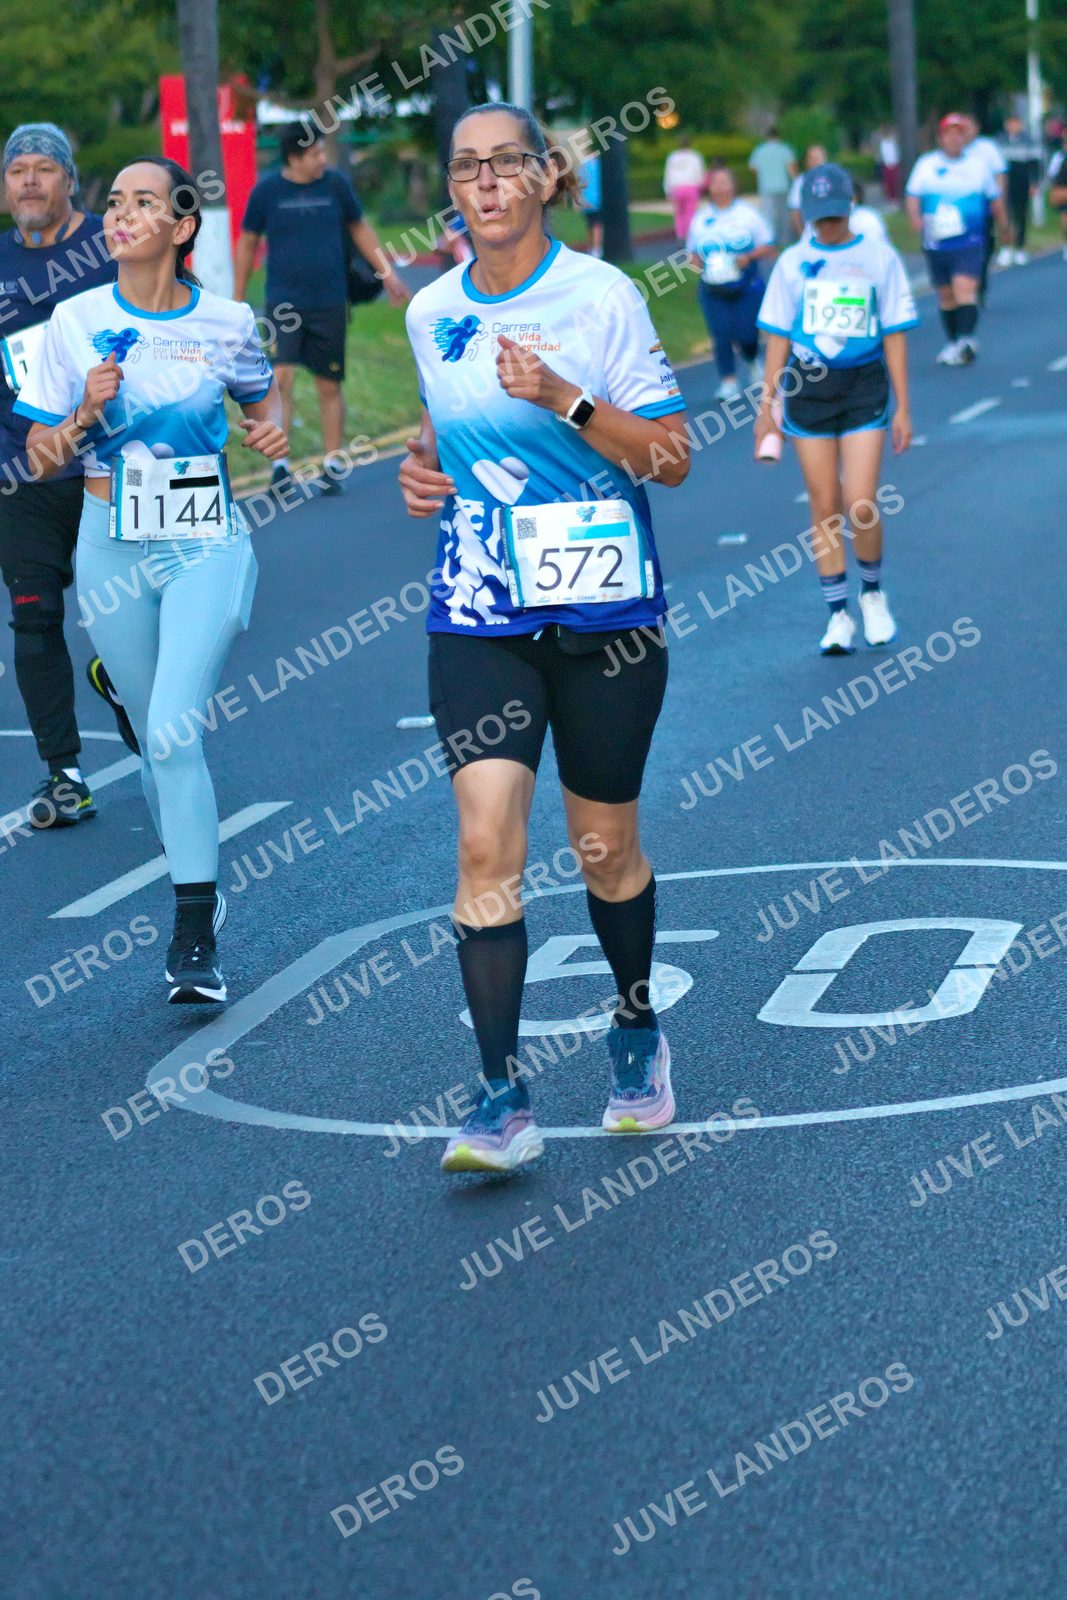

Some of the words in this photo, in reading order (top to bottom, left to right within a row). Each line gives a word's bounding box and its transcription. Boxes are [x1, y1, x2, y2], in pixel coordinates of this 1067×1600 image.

[492, 322, 541, 333] Carrera
[809, 304, 867, 331] 1952
[152, 336, 201, 349] Carrera
[518, 332, 542, 343] Vida
[129, 490, 224, 529] 1144
[535, 544, 624, 592] 572
